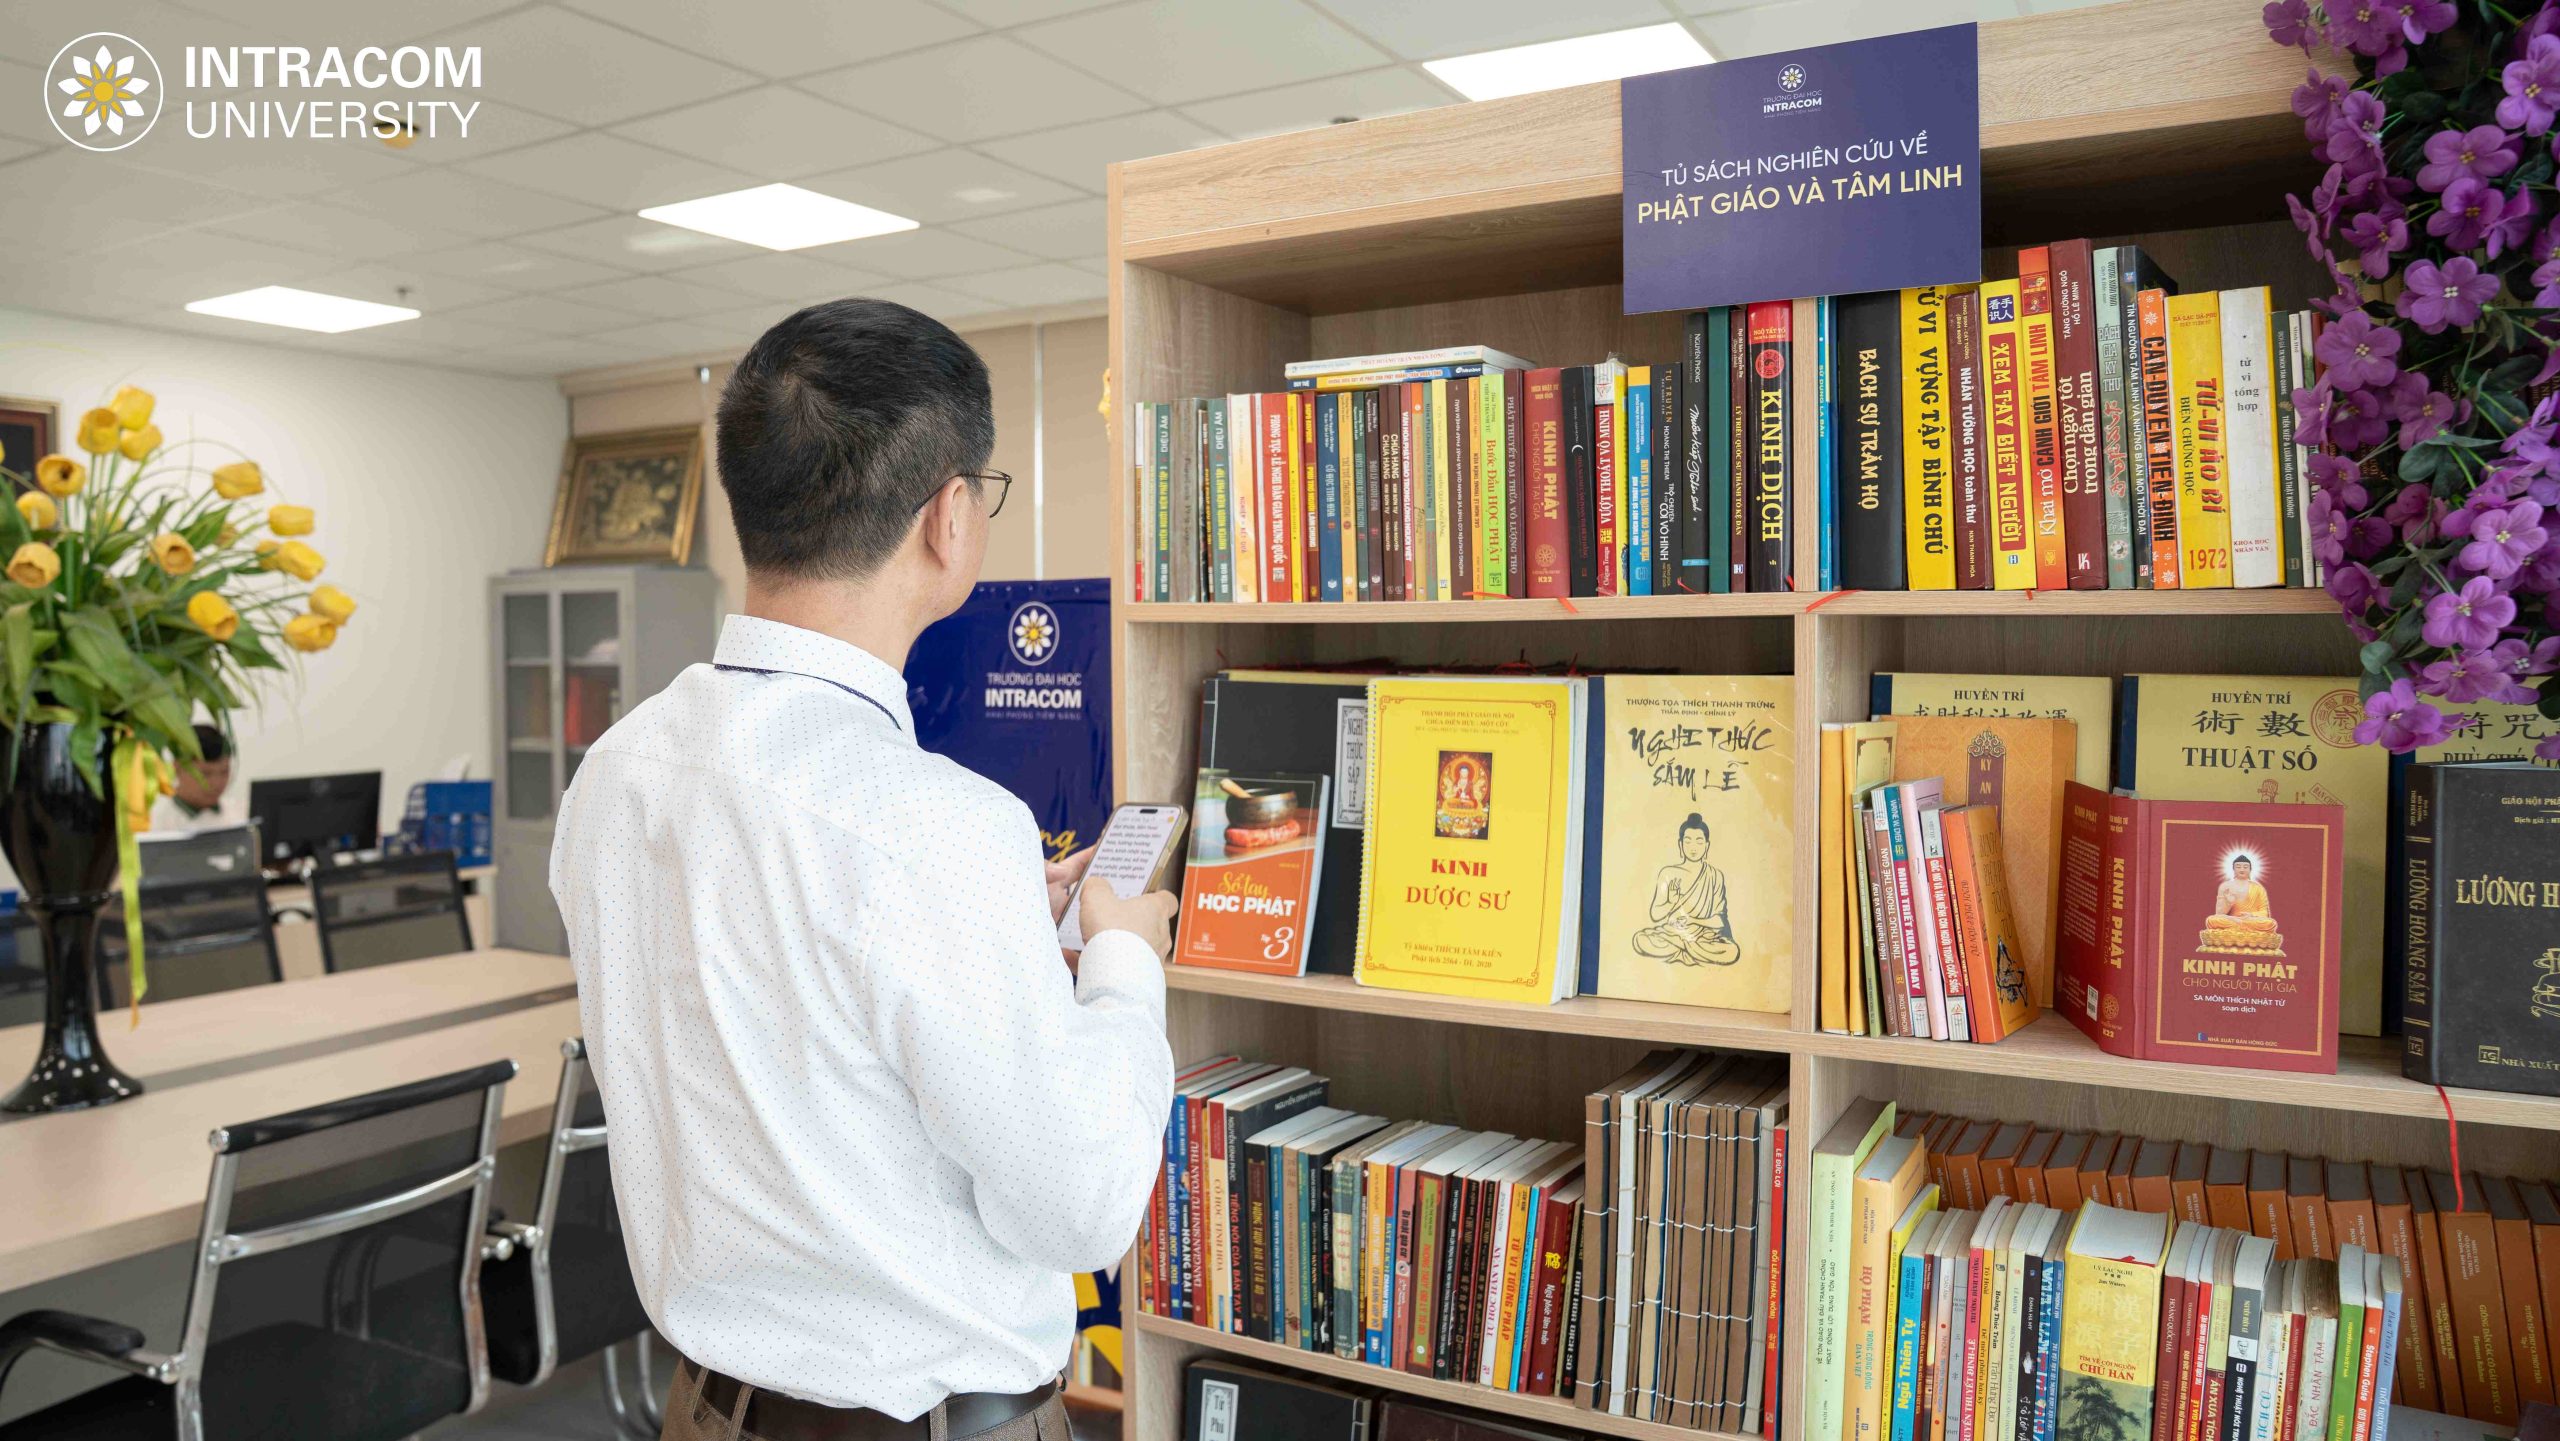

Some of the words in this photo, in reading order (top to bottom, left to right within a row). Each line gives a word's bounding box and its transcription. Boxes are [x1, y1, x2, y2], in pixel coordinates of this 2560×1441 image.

[1763, 97, 1822, 113] INTRACOM
[1660, 163, 1685, 187] TỦ
[1692, 159, 1750, 182] SÁCH
[1756, 146, 1838, 175] NGHIÊN
[1844, 139, 1893, 163] CỨU
[1899, 130, 1927, 157] VỀ
[1637, 193, 1703, 225] PHẬT
[1710, 184, 1779, 215] GIÁO
[1786, 176, 1824, 206] VÀ
[1831, 170, 1890, 201] TÂM
[1899, 164, 1962, 193] LINH
[1918, 311, 1937, 334] VI
[2027, 323, 2048, 356] LINH
[1858, 348, 1880, 399] BÁCH
[1915, 347, 1942, 405] VỰNG
[1991, 343, 2016, 385] XEM
[2028, 359, 2050, 393] TÂM
[2241, 372, 2251, 382] vi
[1960, 367, 1974, 401] NHÂN
[2057, 376, 2074, 401] tốt
[2076, 371, 2097, 407] gian
[1856, 404, 1881, 426] SỰ
[1994, 389, 2016, 428] TAY
[2030, 395, 2052, 424] GIỚI
[2060, 402, 2078, 445] ngày
[2178, 396, 2193, 423] BIỆN
[1599, 410, 1610, 439] MINH
[1760, 388, 1782, 464] KINH
[1916, 409, 1946, 450] TẬP
[2078, 408, 2094, 445] dân
[1486, 439, 1498, 468] Bước
[1543, 421, 1557, 467] KINH
[1596, 440, 1611, 456] VÔ
[1860, 429, 1883, 479] TRĂM
[1996, 434, 2022, 477] BIẾT
[2033, 428, 2055, 467] CẢNH
[2180, 427, 2196, 468] CHỨNG
[1962, 447, 1977, 474] HỌC
[2062, 446, 2081, 494] Chọn
[2081, 446, 2099, 494] trong
[1597, 458, 1612, 494] THOÁT
[1921, 458, 1947, 508] BÌNH
[1964, 476, 1976, 502] toàn
[2036, 469, 2054, 496] mở
[2182, 470, 2195, 496] HỌC
[1272, 501, 1283, 519] GIAN
[1484, 495, 1499, 526] HỌC
[1540, 472, 1559, 520] PHẬT
[1598, 494, 1613, 524] VƯỢT
[1755, 471, 1784, 542] DỊCH
[1856, 484, 1879, 510] HỌ
[1965, 503, 1978, 524] thư
[1998, 482, 2023, 544] NGƯỜI
[2039, 500, 2057, 536] Khai
[1273, 519, 1284, 543] TRUNG
[1486, 528, 1503, 564] PHẬT
[1923, 512, 1949, 555] CHÚ
[2188, 548, 2227, 571] 1972
[985, 688, 1082, 708] INTRACOM
[1626, 698, 1660, 707] THƯỢNG
[1662, 699, 1679, 709] TỌA
[1682, 698, 1708, 708] THÍCH
[1711, 700, 1743, 708] THANH
[1954, 688, 1999, 701] HUYỀN
[2002, 687, 2025, 701] TRÍ
[2212, 691, 2257, 704] HUYỀN
[2262, 691, 2291, 704] TRÍ
[2181, 746, 2275, 774] THUẬT
[2281, 744, 2318, 771] SỐ
[1980, 782, 1991, 794] AN
[1431, 858, 1488, 878] KINH
[1896, 867, 1911, 898] MINH
[1197, 892, 1241, 914] HỌC
[1243, 896, 1296, 919] PHẬT
[1406, 885, 1472, 911] DƯỢC
[1478, 889, 1512, 911] SƯ
[2456, 873, 2536, 908] LƯƠNG
[1900, 898, 1917, 929] TRIẾT
[1263, 926, 1295, 960] 3
[2408, 912, 2430, 968] HOÀNG
[1907, 951, 1920, 967] VÀ
[2182, 958, 2236, 976] KINH
[2243, 960, 2298, 982] PHẬT
[1910, 968, 1921, 990] NAY
[2182, 976, 2209, 988] CHO
[2212, 978, 2252, 991] NGƯỜI
[2255, 980, 2273, 993] TẠI
[2276, 981, 2297, 993] GIA
[2205, 993, 2224, 1003] MÔN
[2226, 995, 2249, 1004] THÍCH
[2251, 996, 2273, 1007] NHẬT
[2221, 1005, 2239, 1013] soạn
[2240, 1005, 2256, 1014] dịch
[1858, 1265, 1873, 1283] HỌ
[1857, 1287, 1873, 1324] PHẠM
[1898, 1340, 1914, 1378] Thiên
[2314, 1341, 2324, 1364] TÂM
[2363, 1344, 2375, 1377] Stephen
[1897, 1381, 1912, 1409] Ngũ
[2310, 1369, 2323, 1400] NHÂN
[2359, 1378, 2371, 1401] Guise
